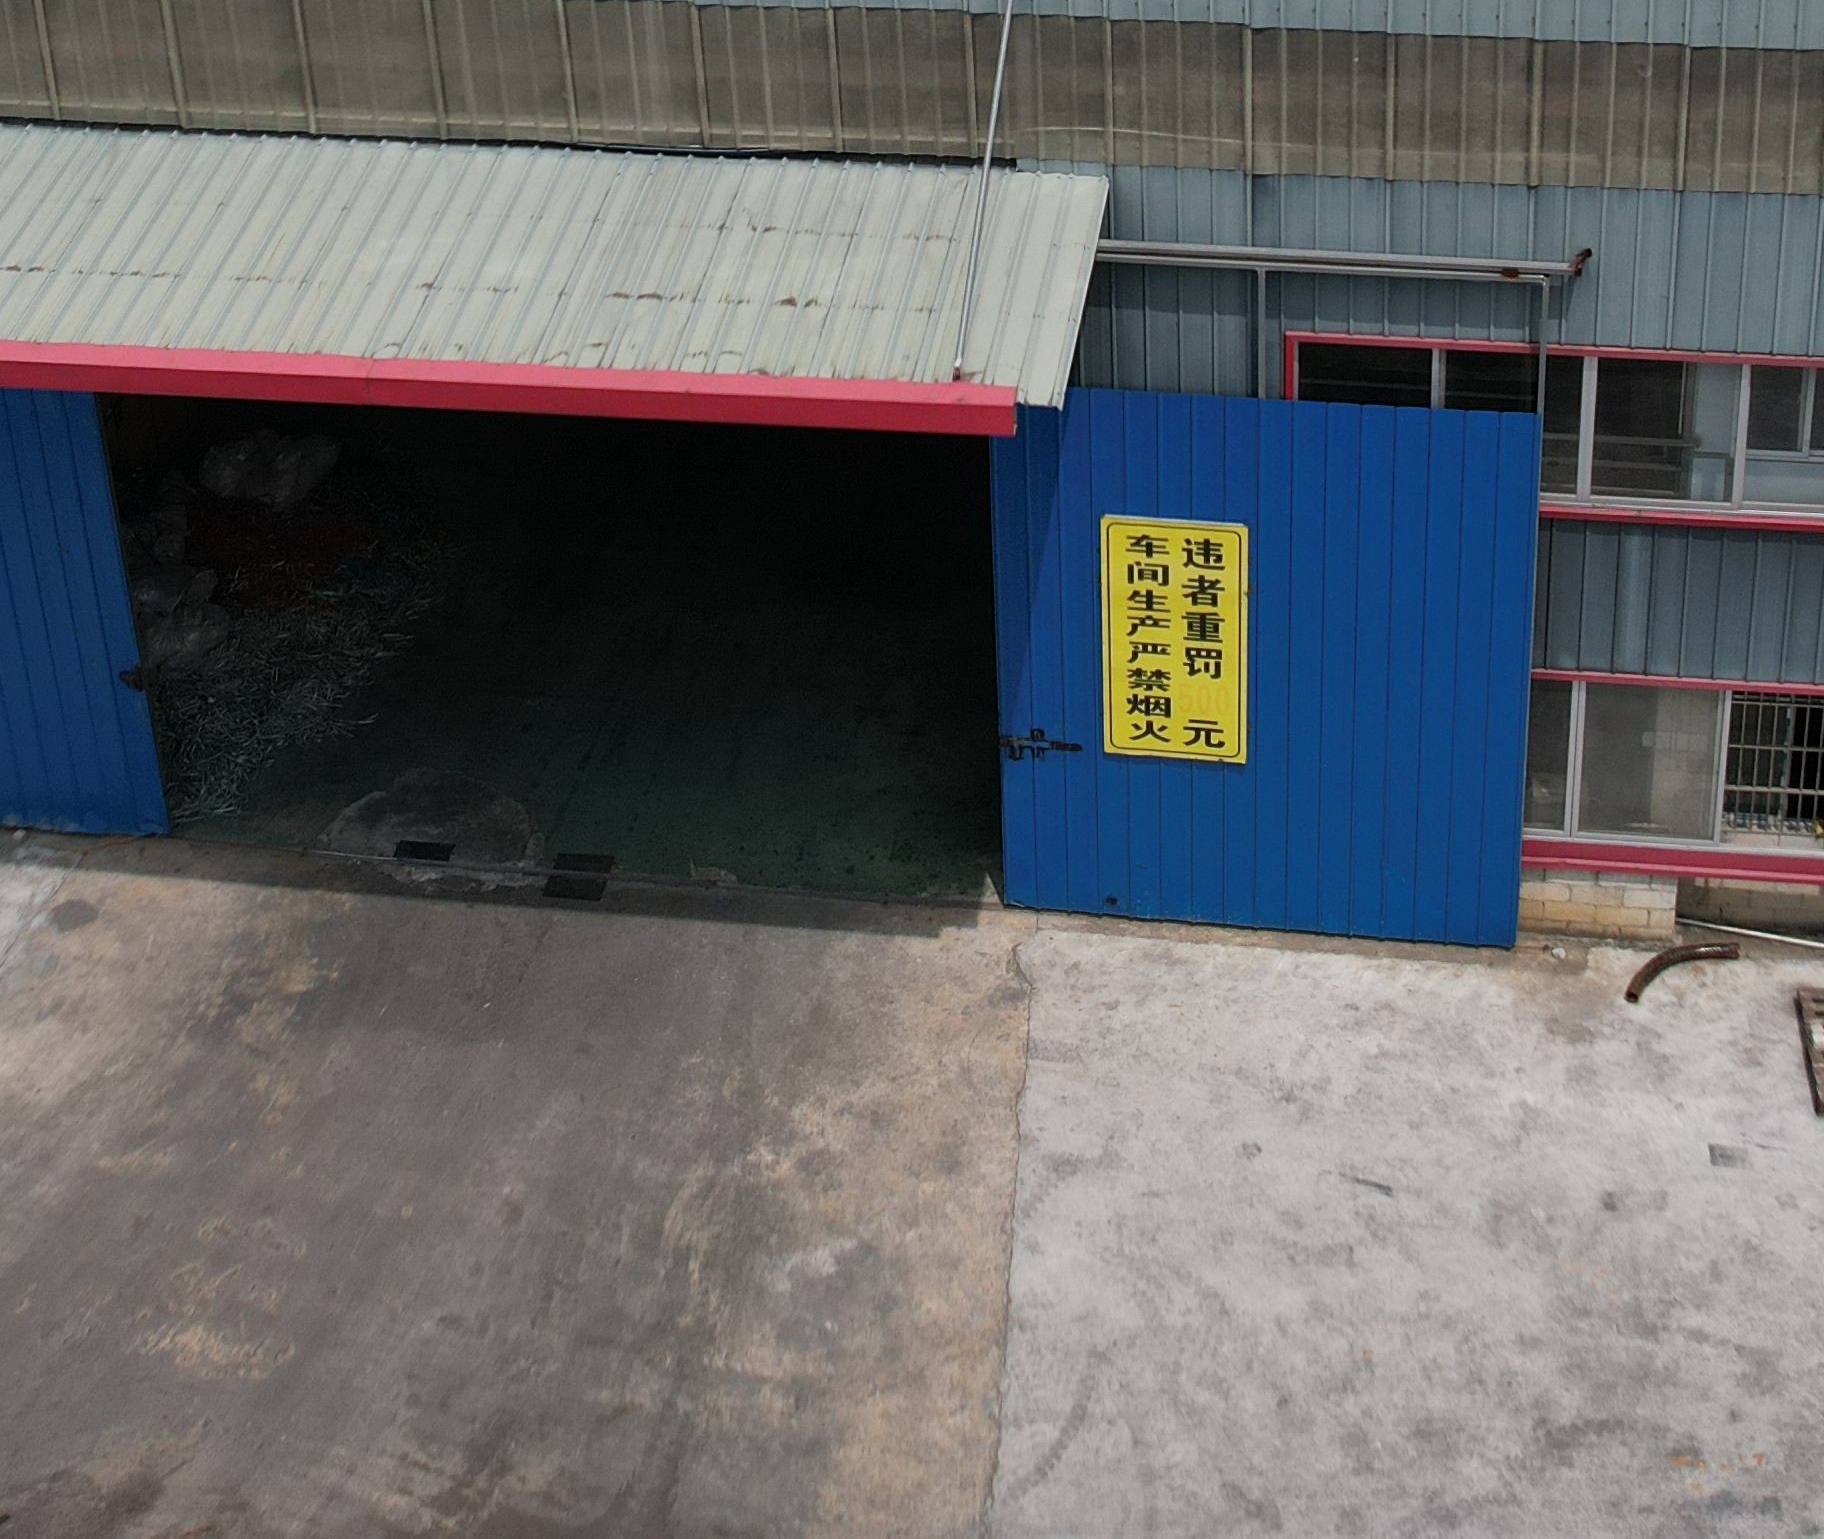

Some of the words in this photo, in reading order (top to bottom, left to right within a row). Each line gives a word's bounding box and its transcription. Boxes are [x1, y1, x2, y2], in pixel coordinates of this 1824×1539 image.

[1125, 534, 1172, 744] 车间生产严禁烟火
